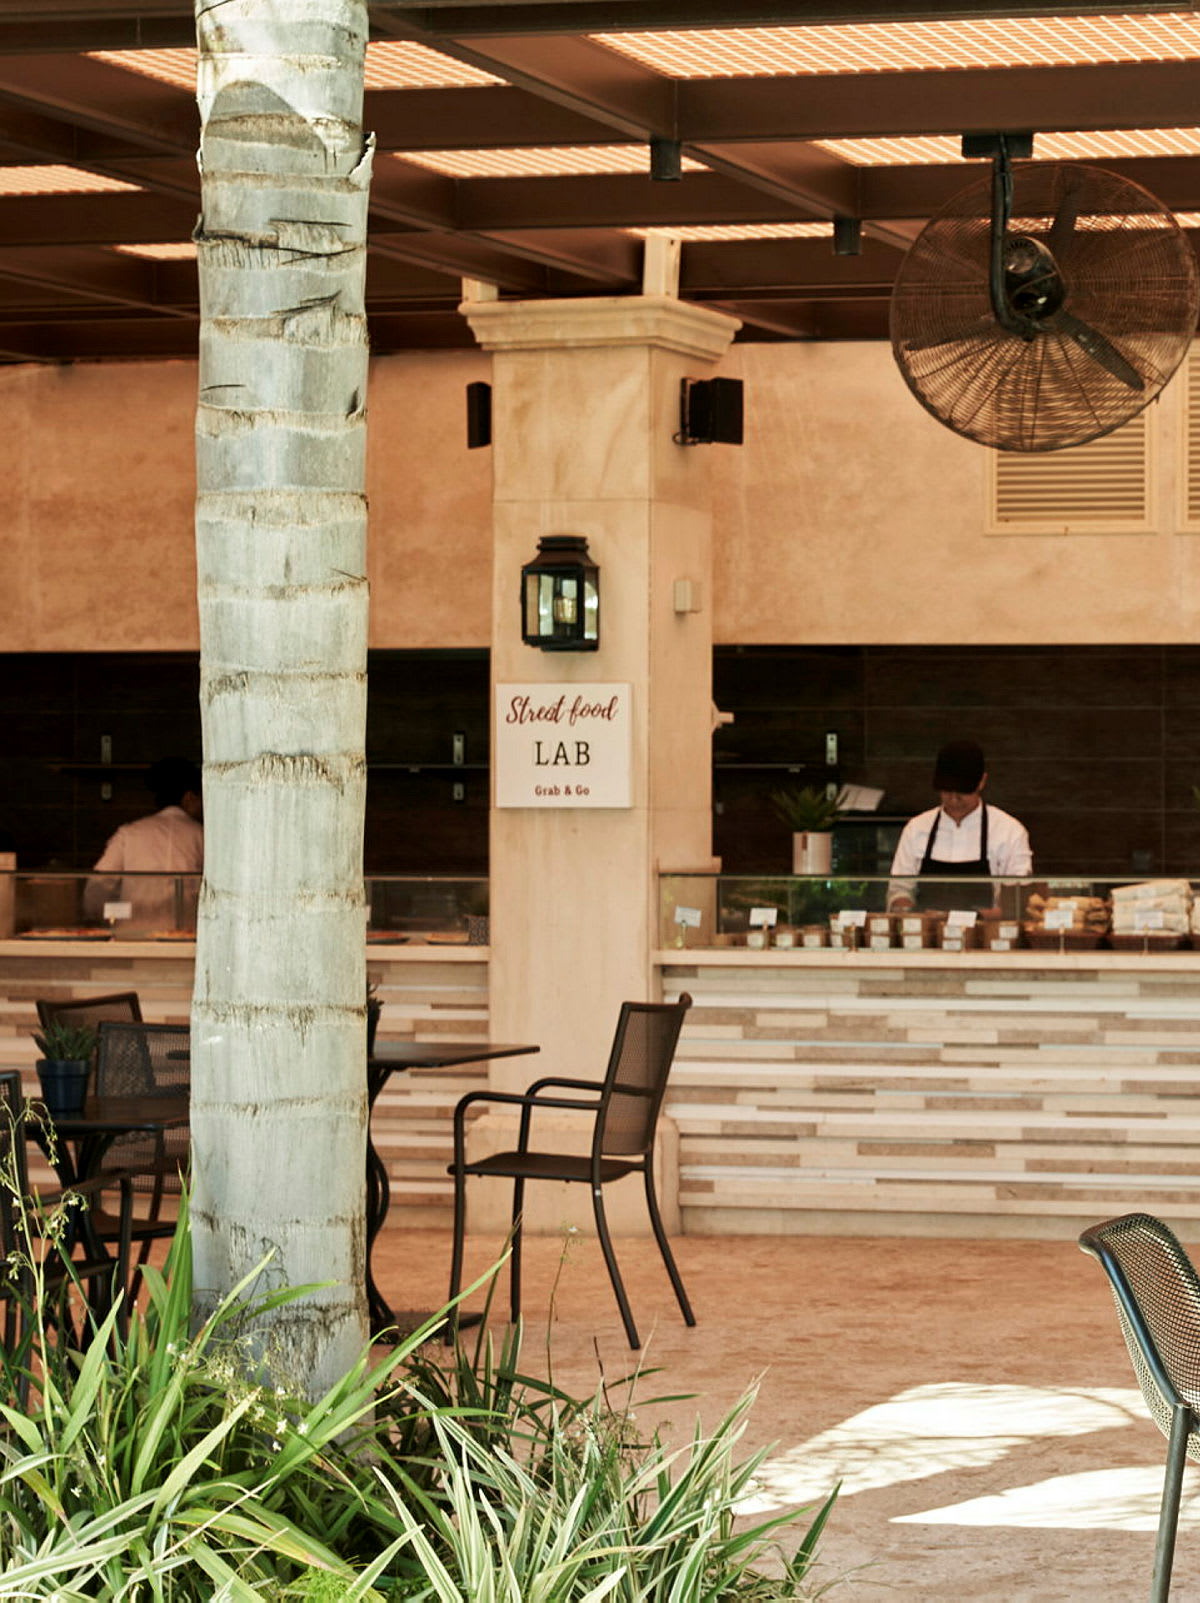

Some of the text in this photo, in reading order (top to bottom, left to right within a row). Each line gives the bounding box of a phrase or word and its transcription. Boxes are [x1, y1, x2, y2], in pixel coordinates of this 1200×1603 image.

[506, 695, 618, 726] Street food
[535, 741, 591, 766] LAB
[535, 785, 590, 796] Grab & Go
